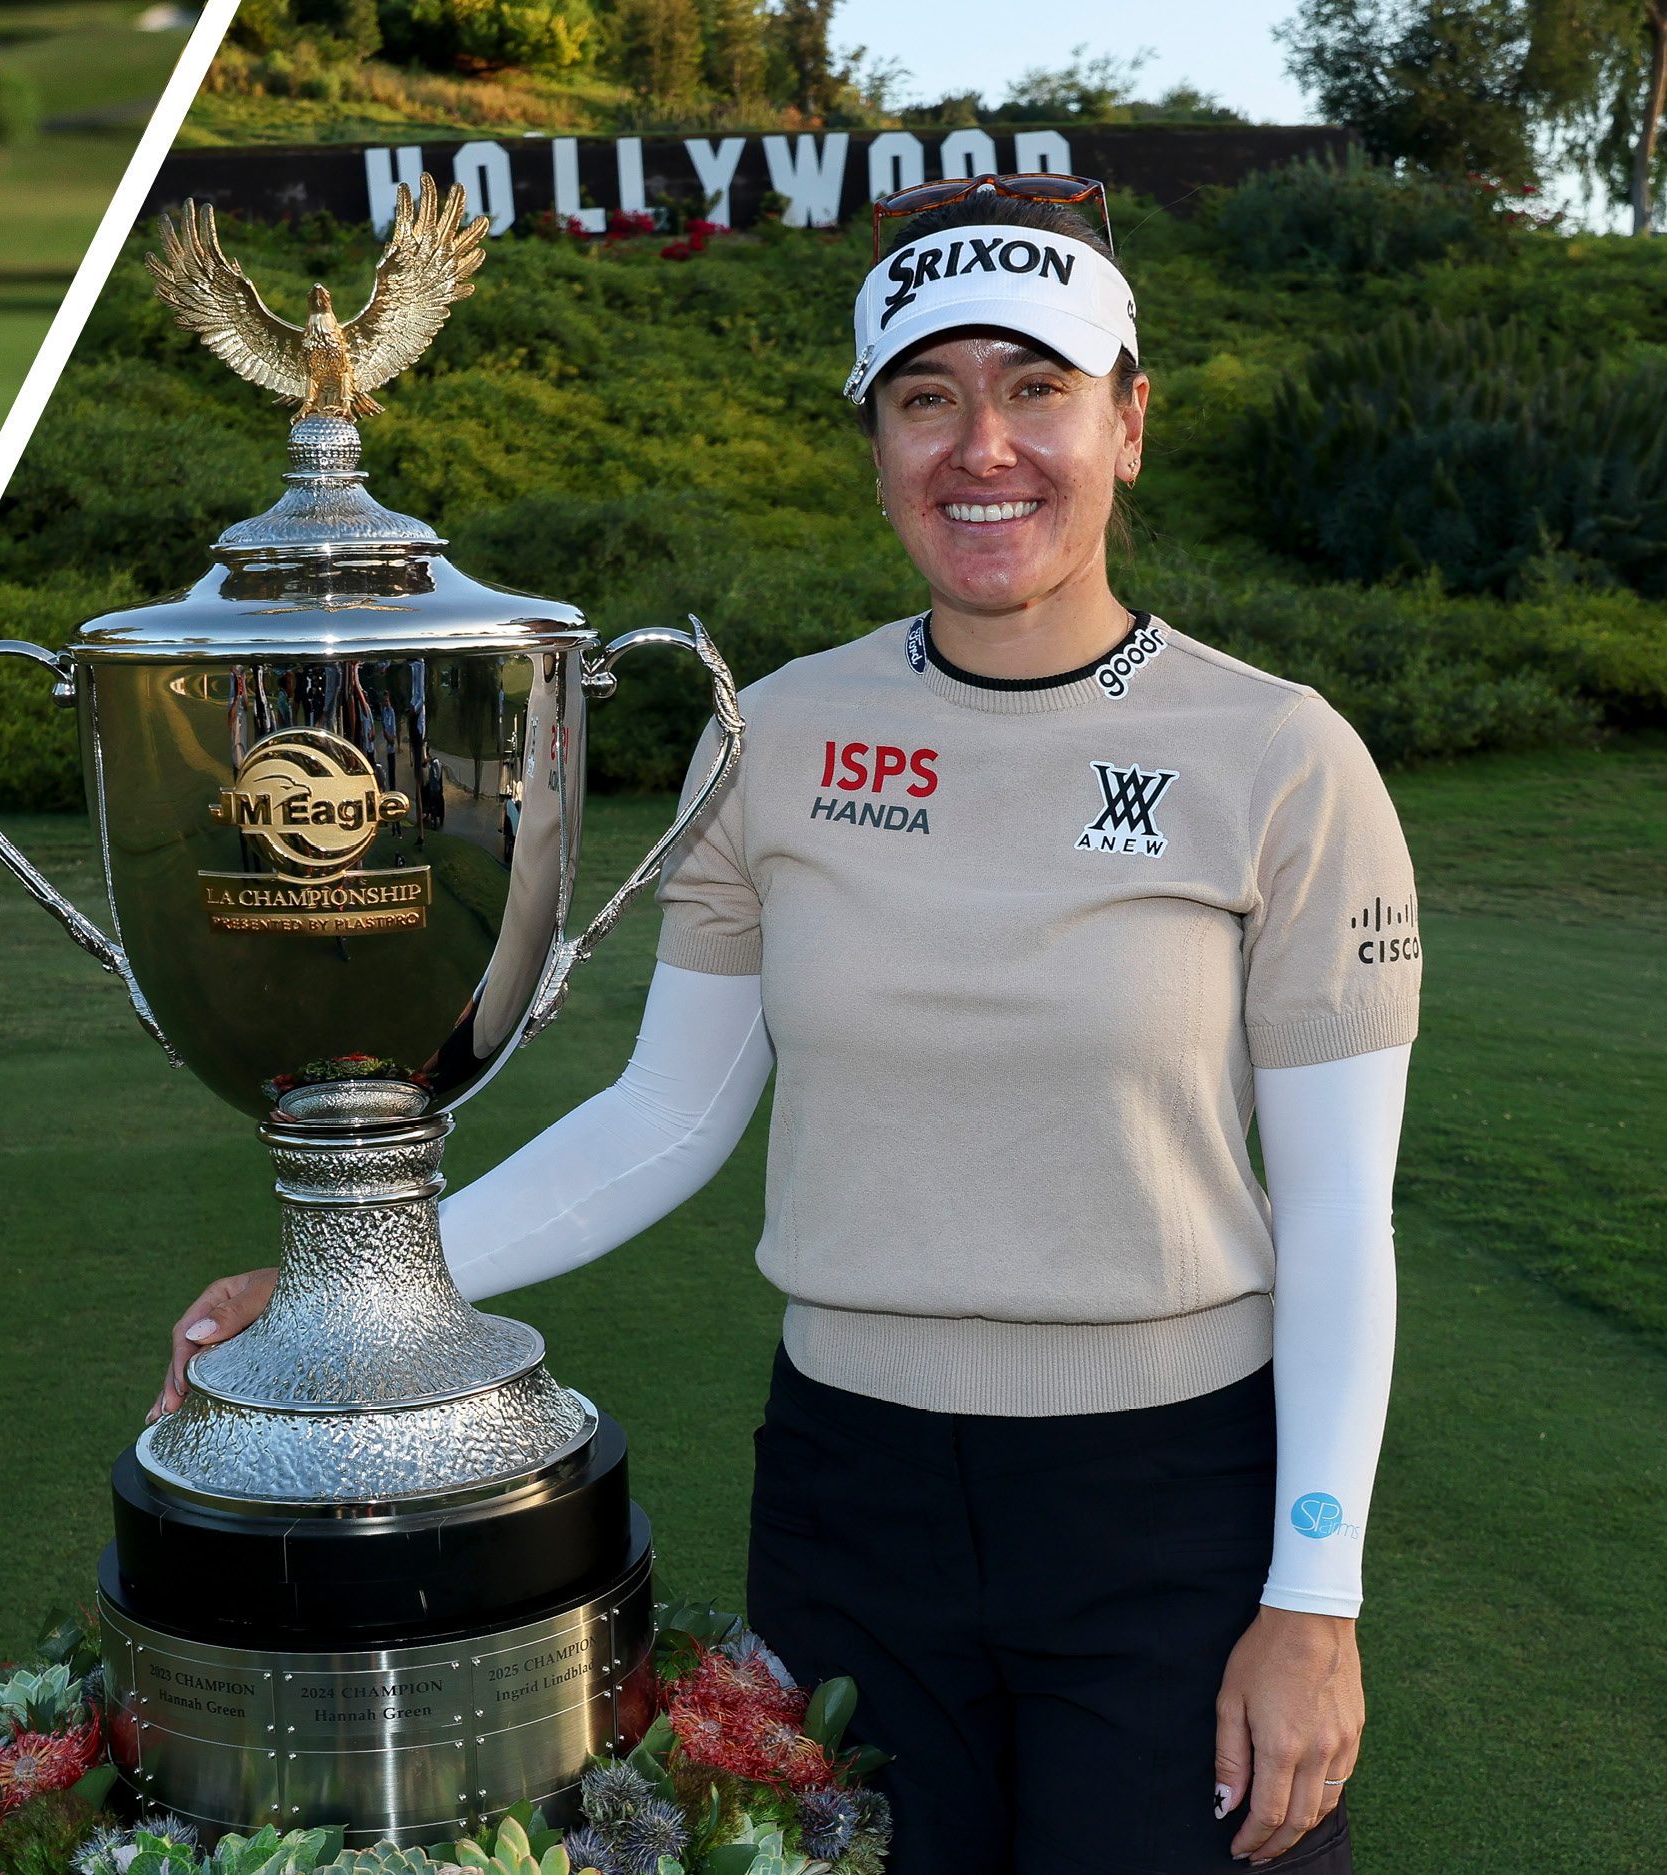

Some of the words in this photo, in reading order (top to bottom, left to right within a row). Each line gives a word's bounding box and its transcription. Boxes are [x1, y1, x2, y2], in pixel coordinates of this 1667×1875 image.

[880, 237, 1075, 330] SRIXON
[908, 626, 923, 665] Ford
[1099, 628, 1164, 697] goodr
[820, 741, 939, 798] ISPS
[281, 790, 410, 832] Eagle
[810, 796, 930, 835] HANDA
[1077, 835, 1165, 856] ANEW
[206, 888, 235, 905] LA
[238, 883, 422, 908] CHAMPIONSHIP
[211, 915, 303, 932] PRESENTED
[309, 917, 330, 931] BY
[335, 911, 421, 931] PLASTPRO
[1358, 936, 1419, 964] CISCO
[488, 1663, 519, 1682] 2025
[524, 1636, 596, 1672] CHAMPION
[149, 1664, 172, 1681] 2023
[175, 1672, 255, 1696] CHAMPION
[301, 1686, 335, 1699] 2024
[341, 1679, 443, 1699] CHAMPION
[496, 1681, 539, 1702] Ingrid
[543, 1657, 595, 1689] Lindblad
[159, 1688, 202, 1711] Hannah
[206, 1700, 246, 1718] Green
[315, 1708, 376, 1722] Hannah
[383, 1706, 432, 1720] Green
